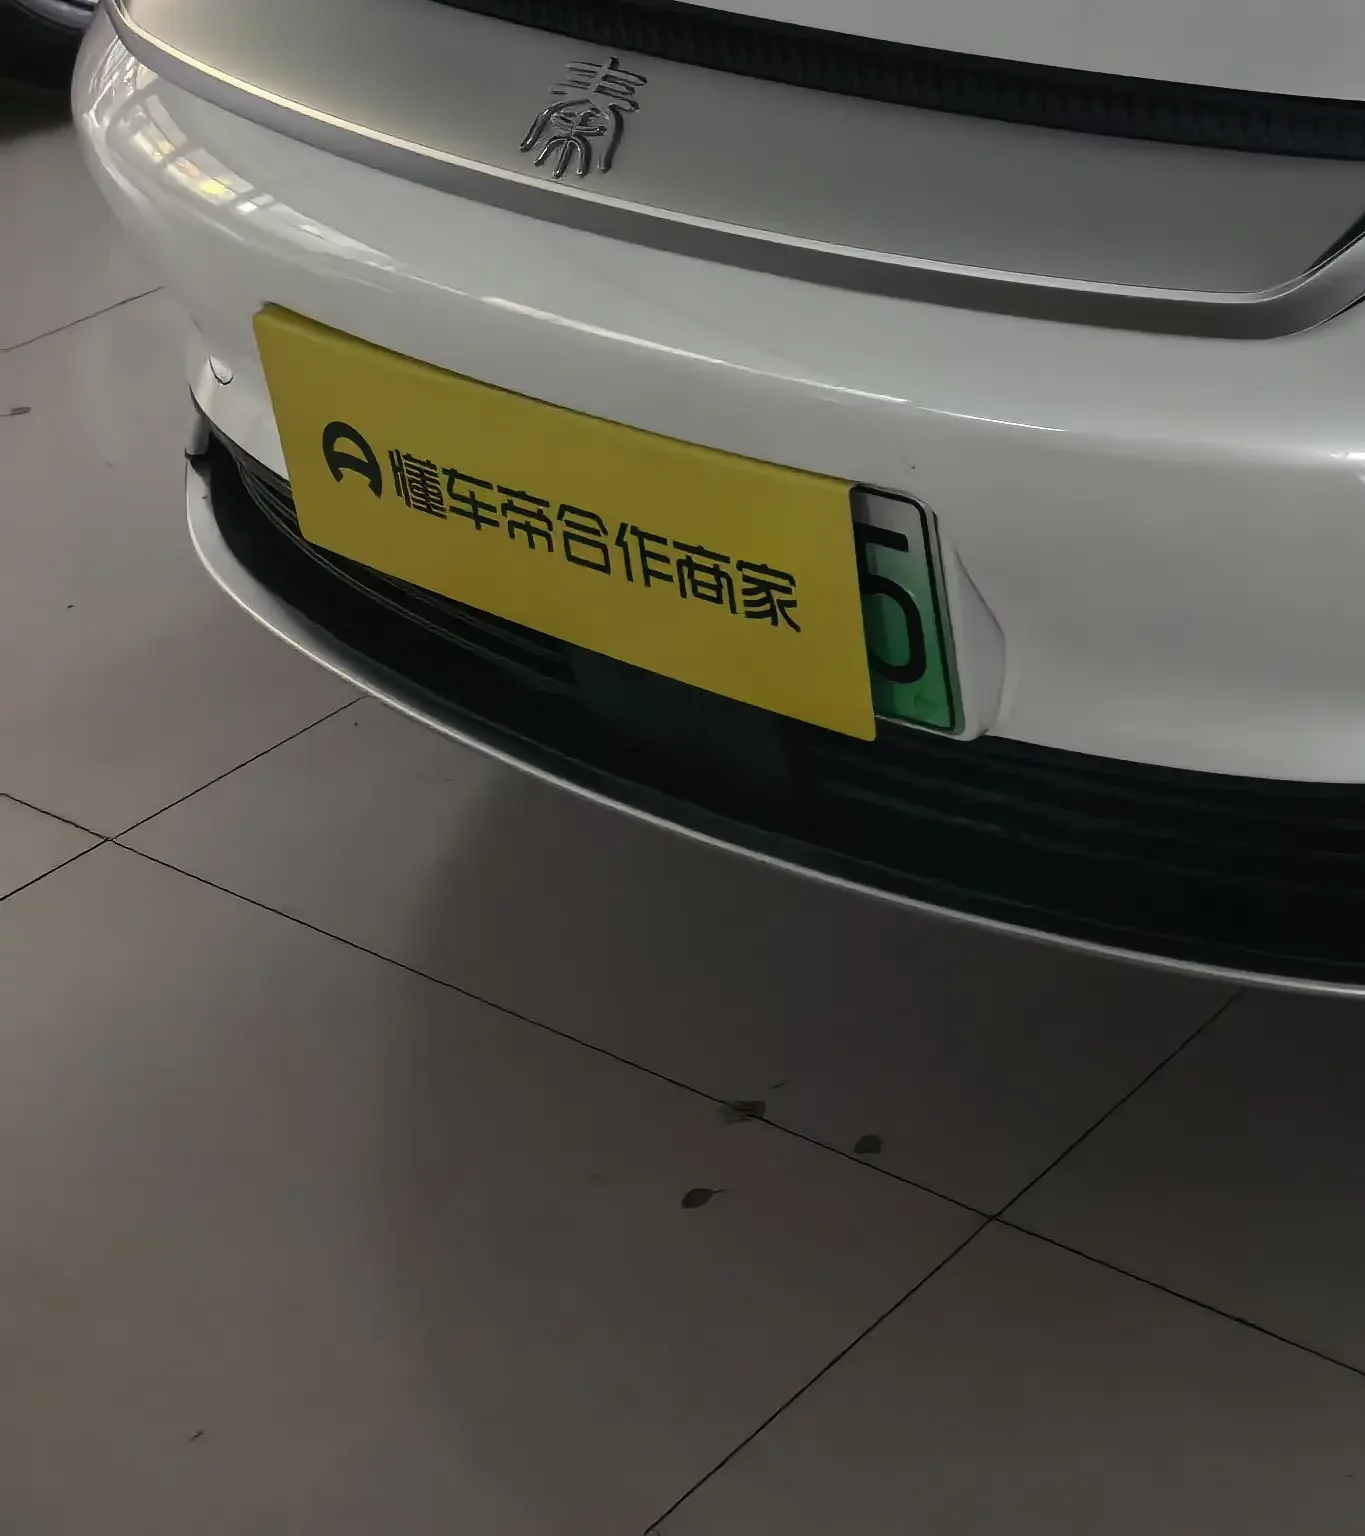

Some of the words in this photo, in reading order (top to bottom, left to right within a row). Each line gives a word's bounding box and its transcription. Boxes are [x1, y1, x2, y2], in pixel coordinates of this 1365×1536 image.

[388, 447, 801, 633] 懂车帝合作商家
